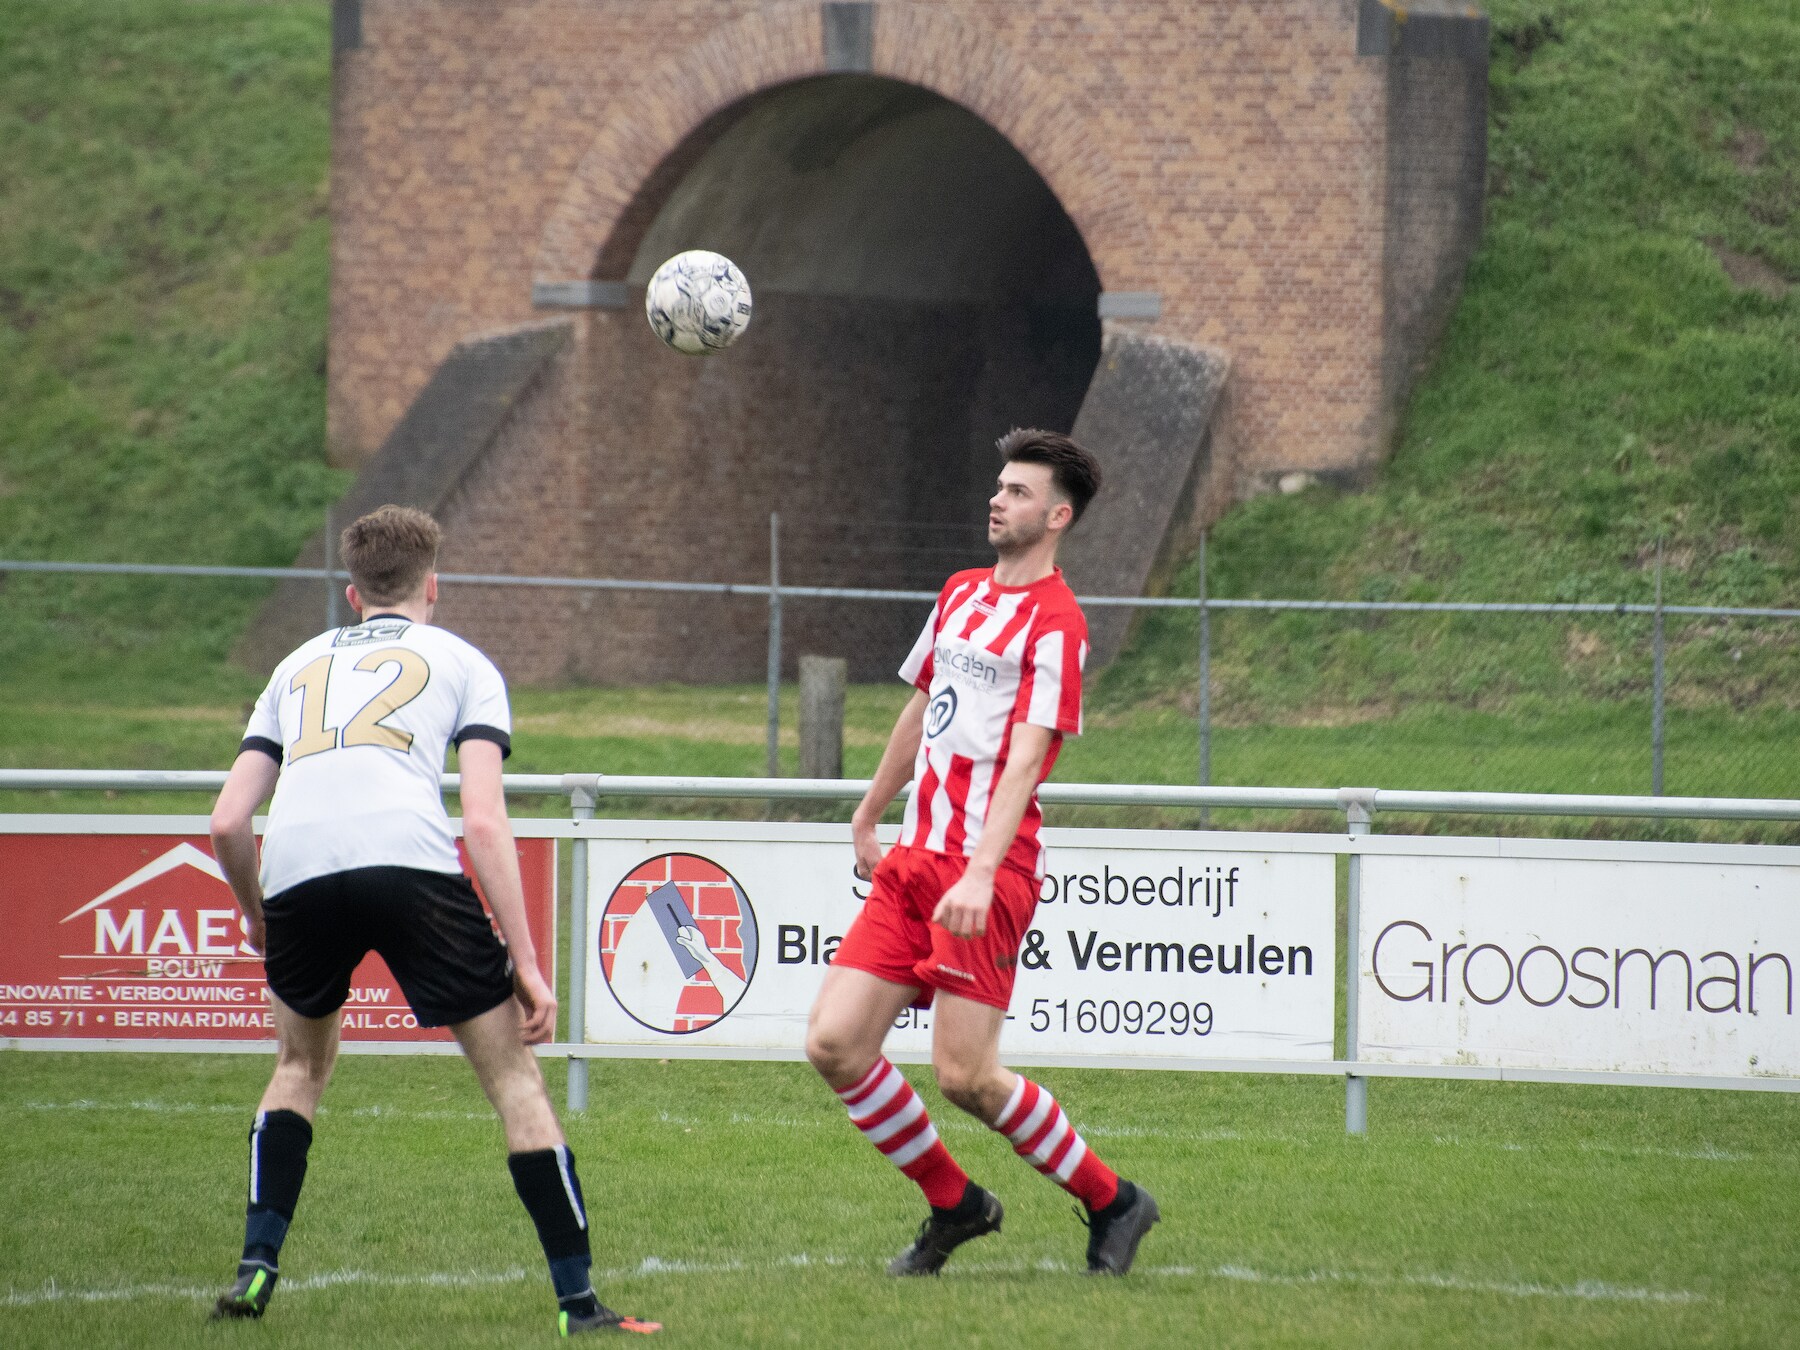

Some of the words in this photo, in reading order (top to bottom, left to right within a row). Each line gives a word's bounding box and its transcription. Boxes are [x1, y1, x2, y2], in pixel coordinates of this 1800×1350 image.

[287, 646, 431, 766] 12
[146, 959, 223, 979] BOUW
[1020, 929, 1053, 970] &
[1066, 929, 1314, 976] Vermeulen
[1372, 919, 1793, 1016] Groosman
[107, 985, 246, 1002] VERBOUWING
[24, 1010, 53, 1027] 85
[59, 1010, 85, 1027] 71
[1029, 998, 1214, 1037] 51609299
